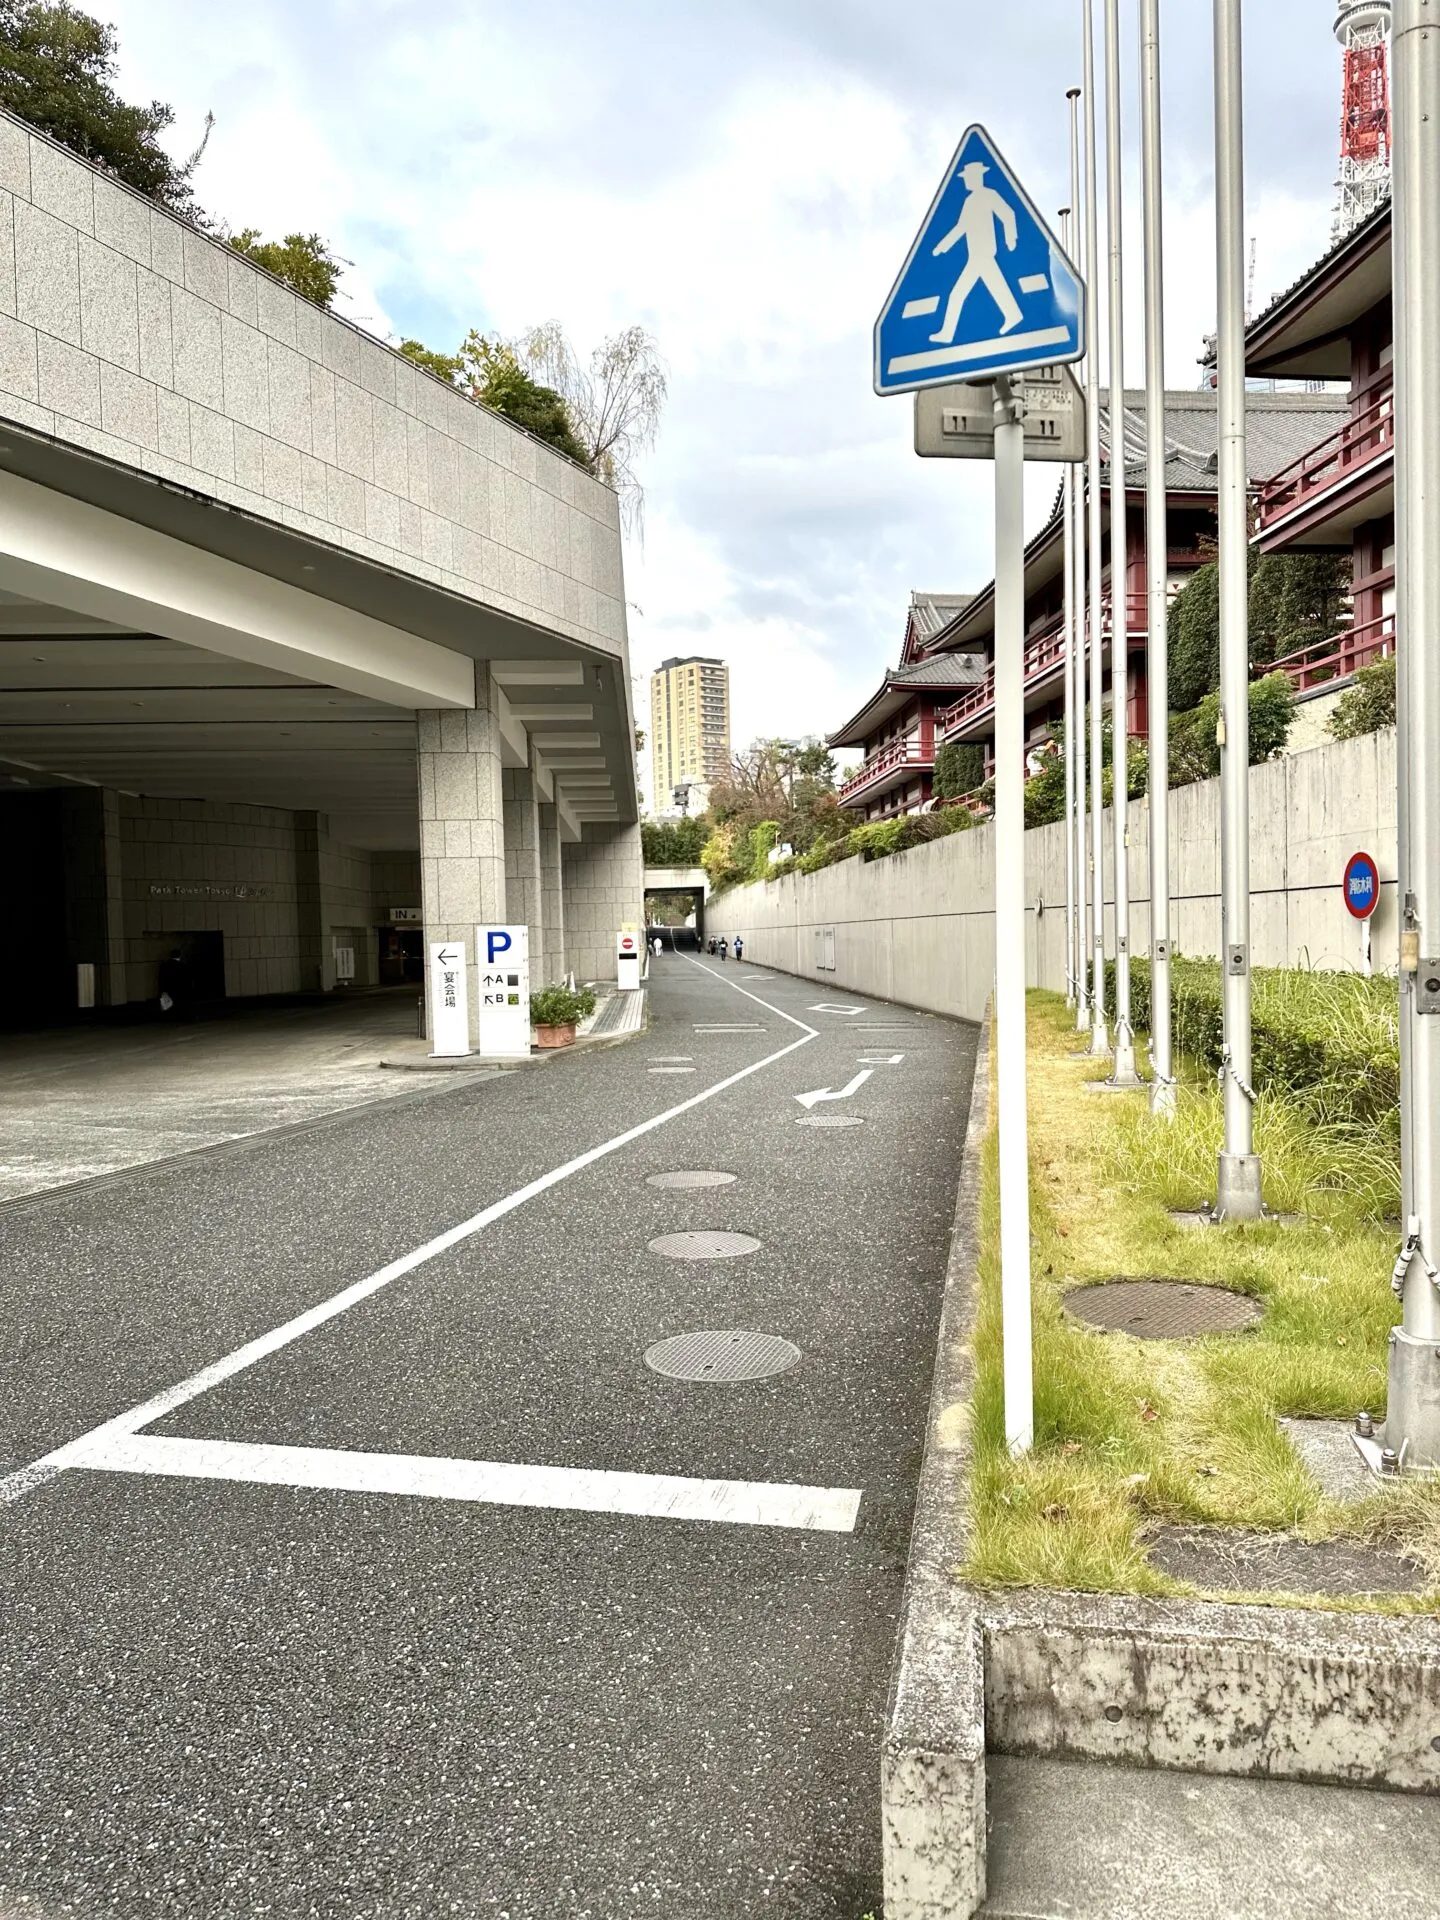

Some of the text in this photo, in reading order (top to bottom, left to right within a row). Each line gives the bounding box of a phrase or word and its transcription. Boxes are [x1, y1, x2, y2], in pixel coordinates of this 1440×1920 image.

[395, 910, 407, 919] IN
[487, 931, 512, 964] P
[495, 974, 504, 984] A
[443, 971, 456, 1008] 宴会場
[495, 993, 504, 1003] B
